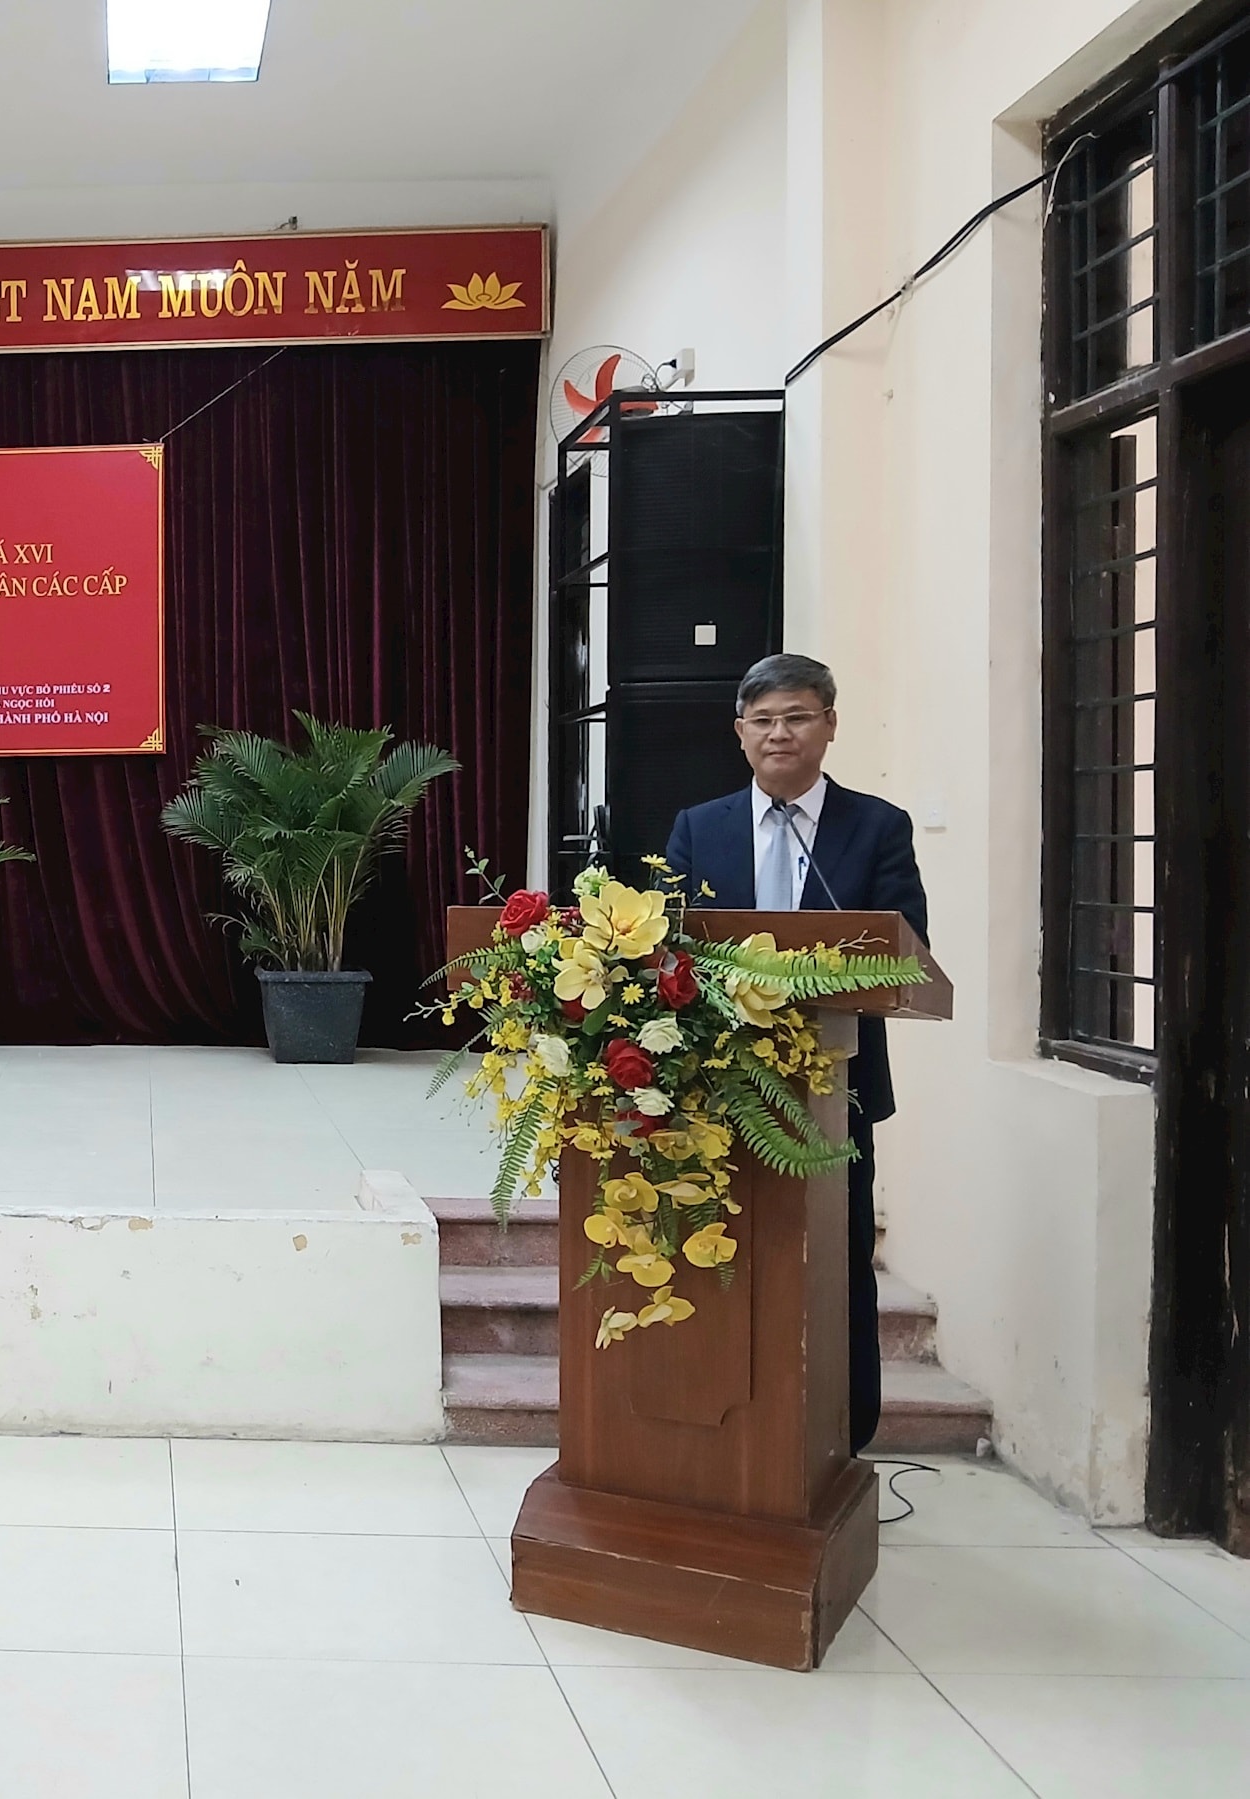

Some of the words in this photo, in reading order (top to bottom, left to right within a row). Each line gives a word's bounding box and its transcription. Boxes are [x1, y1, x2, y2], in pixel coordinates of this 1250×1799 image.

[42, 276, 142, 323] NAM
[158, 259, 287, 318] MUÔN
[303, 259, 407, 314] NĂM
[14, 543, 53, 564] XVI
[32, 570, 78, 597] CÁC
[83, 566, 127, 596] CẤP
[11, 685, 34, 697] VỰC
[102, 684, 111, 693] 2
[2, 699, 33, 710] NGỌC
[63, 710, 82, 723] HÀ
[85, 711, 109, 725] NỘI
